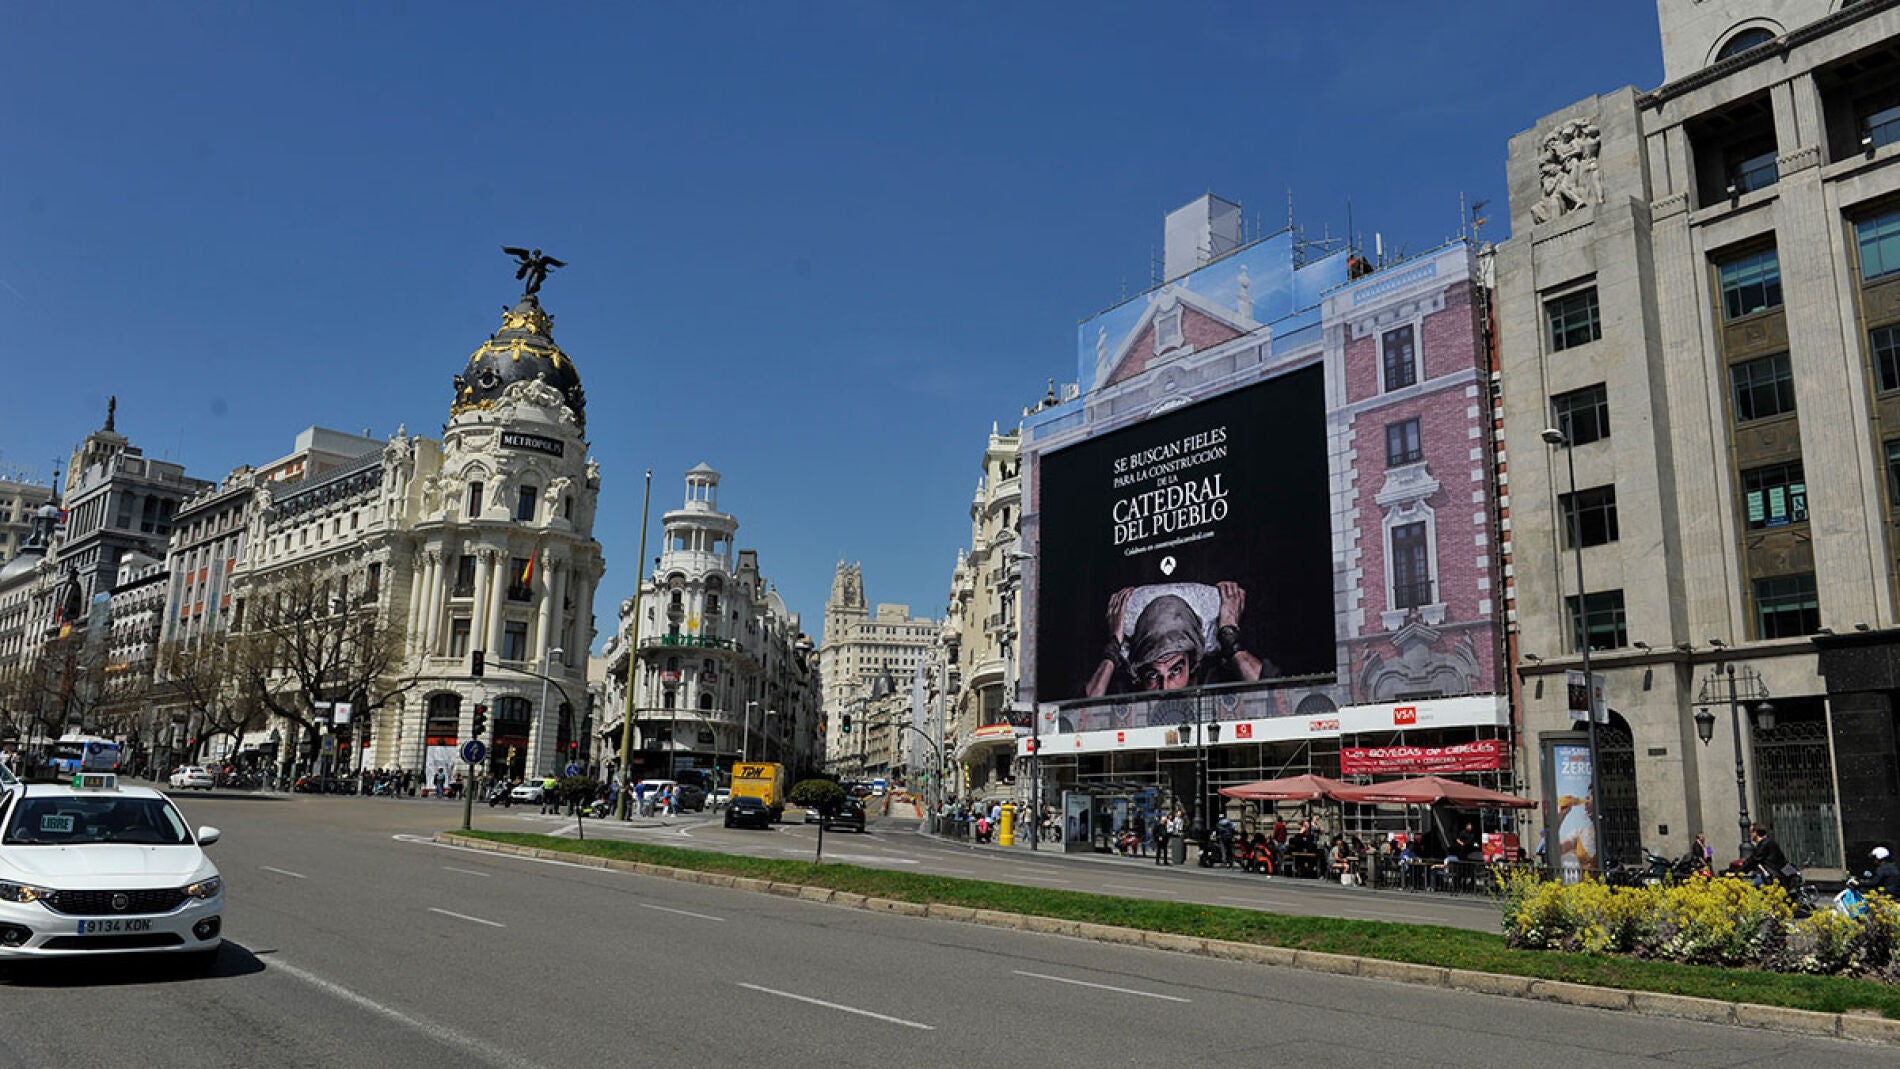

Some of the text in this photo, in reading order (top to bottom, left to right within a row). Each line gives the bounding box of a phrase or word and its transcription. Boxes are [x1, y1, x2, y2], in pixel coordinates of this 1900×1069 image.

[1114, 426, 1227, 475] SE BUSCAN FIELES
[1114, 473, 1135, 489] PARA
[1136, 469, 1148, 483] LA
[1157, 478, 1167, 487] DE
[1112, 473, 1229, 524] CATEDRAL
[1113, 519, 1149, 546] DEL
[1152, 498, 1228, 536] PUEBLO
[87, 919, 120, 932] 9134
